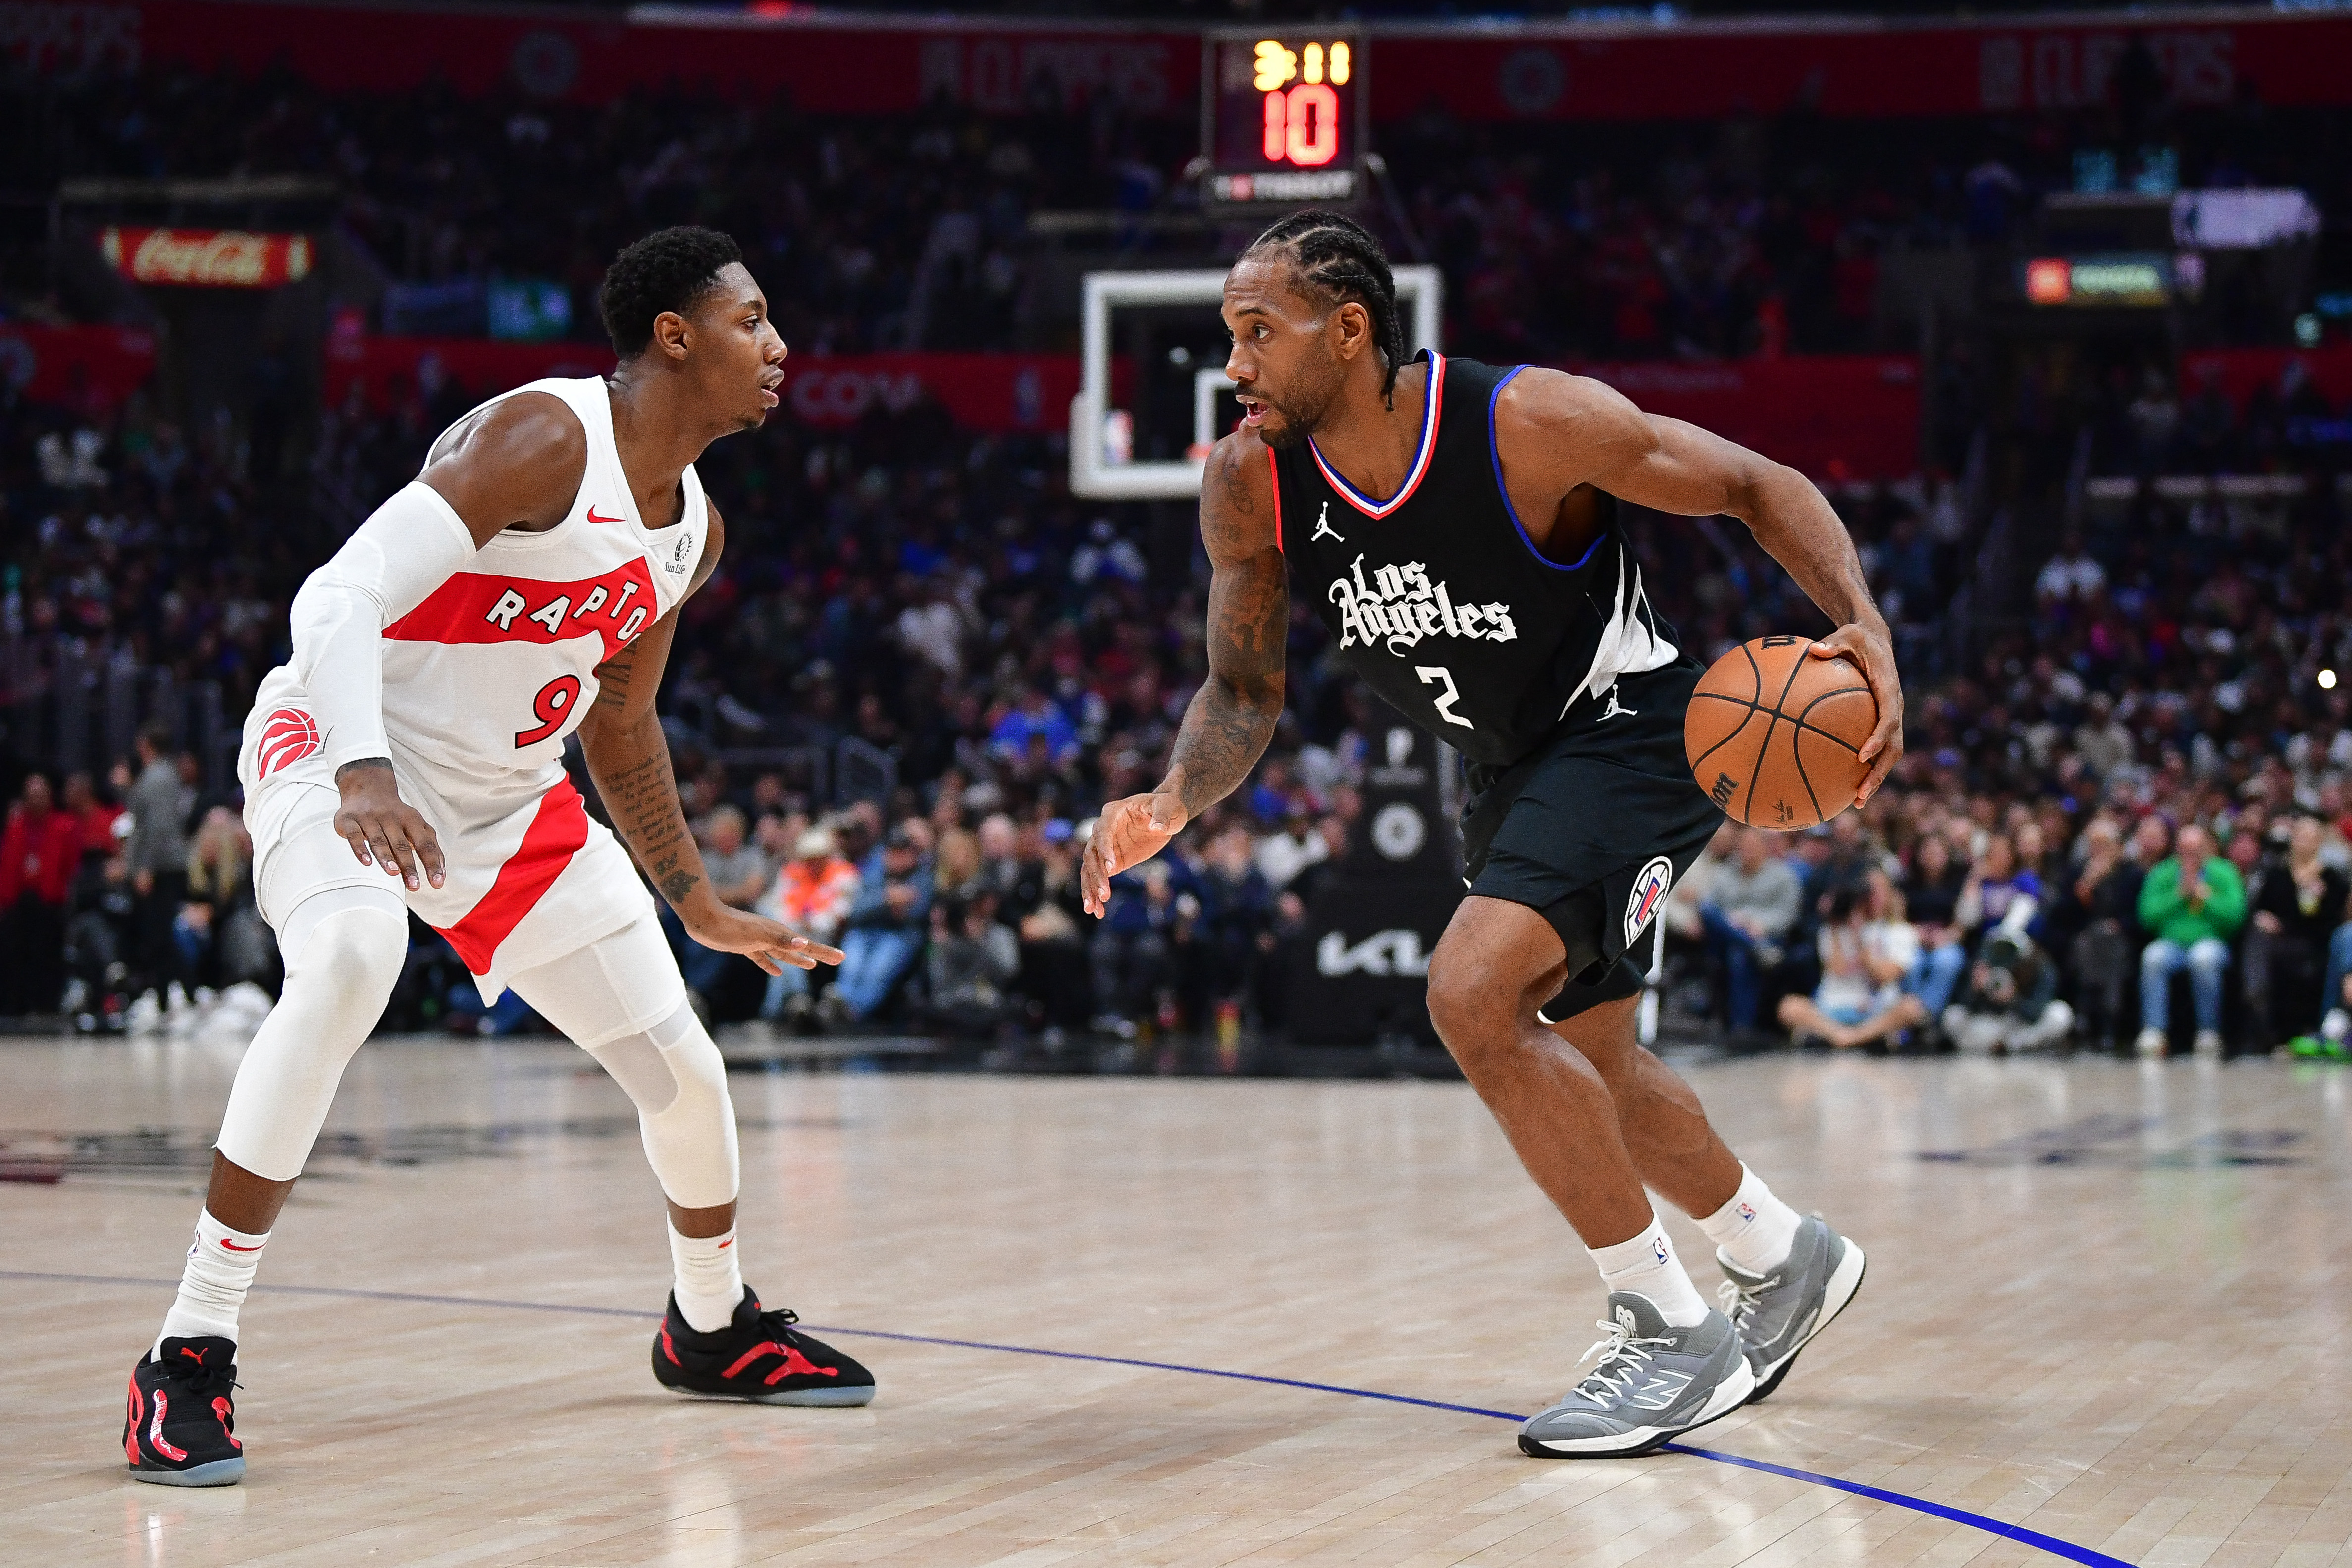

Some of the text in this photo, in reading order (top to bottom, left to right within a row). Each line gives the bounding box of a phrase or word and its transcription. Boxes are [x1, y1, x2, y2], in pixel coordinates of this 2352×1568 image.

[1264, 83, 1337, 165] 10
[664, 561, 685, 575] Sun Life
[1350, 552, 1434, 604] Los
[485, 579, 648, 645] RAPTO
[1328, 578, 1518, 658] Angeles
[514, 674, 582, 750] 9
[1414, 665, 1475, 730] 2
